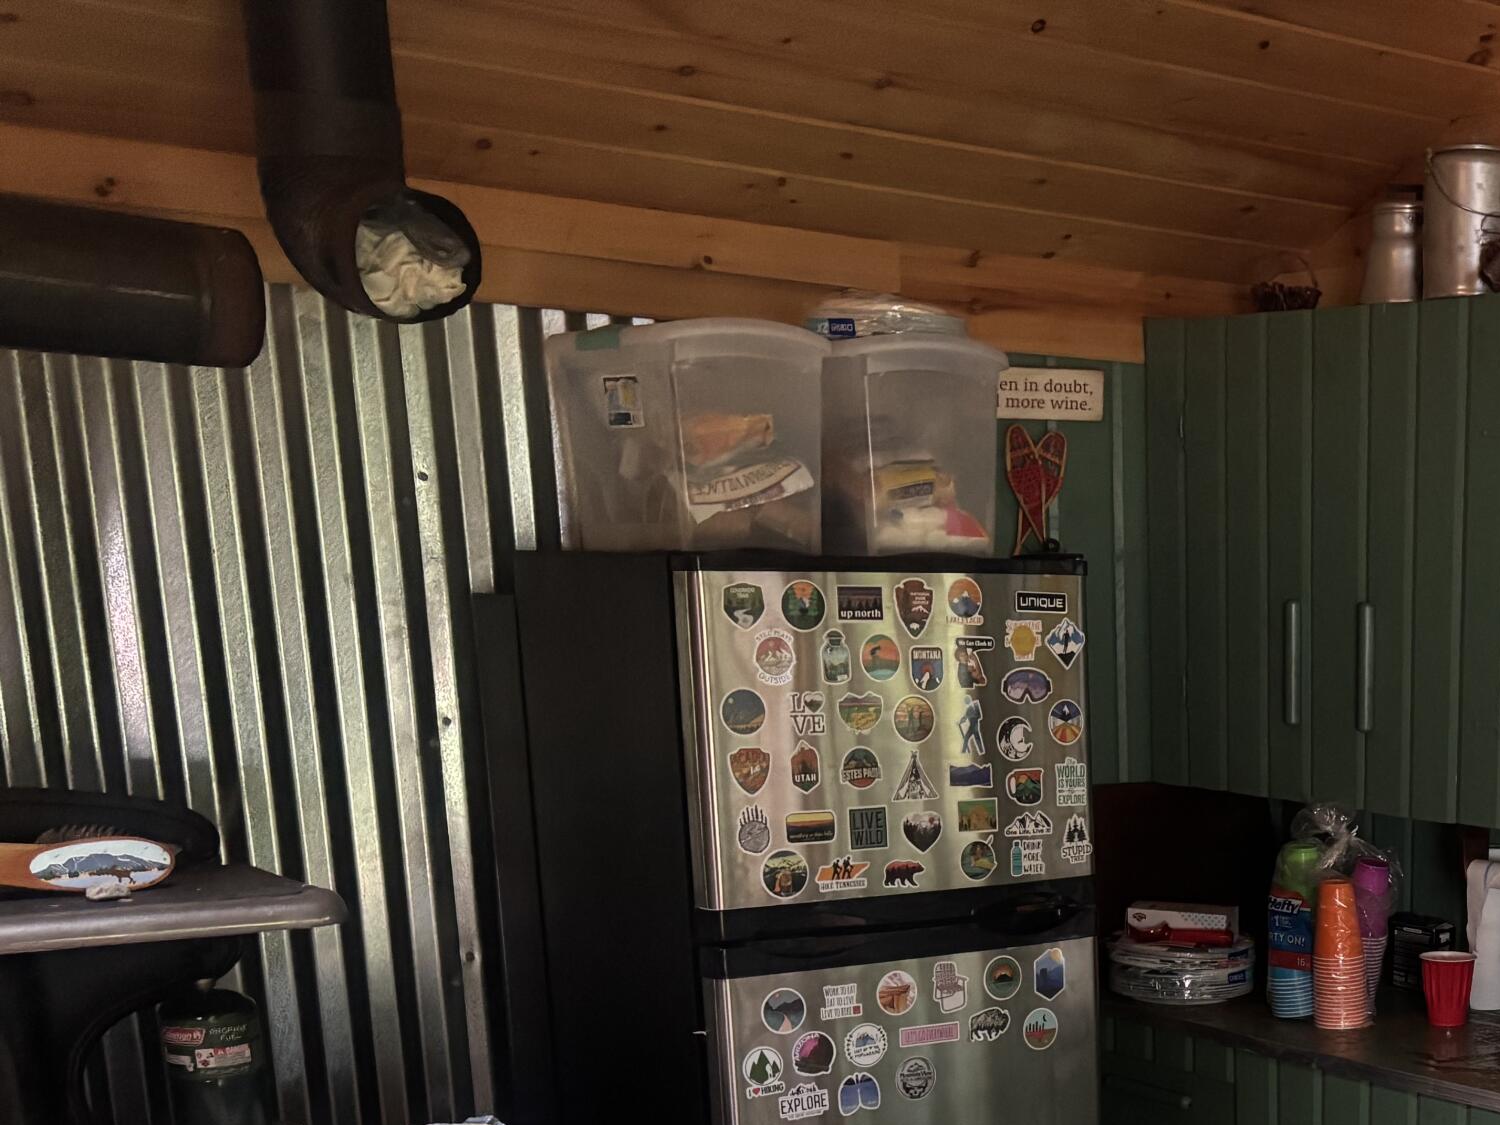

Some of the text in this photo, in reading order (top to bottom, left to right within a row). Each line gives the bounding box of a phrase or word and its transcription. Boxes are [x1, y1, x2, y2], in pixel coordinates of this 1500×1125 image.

[1023, 378, 1039, 392] in
[1043, 378, 1094, 396] doubt,
[1005, 396, 1092, 411] more wine.
[1019, 596, 1064, 609] UNIQUE
[841, 608, 882, 620] up north
[913, 648, 942, 661] MONTANA
[1057, 764, 1086, 778] WORLD
[794, 773, 817, 783] UTAH
[1057, 794, 1086, 804] EXPLORE
[852, 810, 883, 832] LIVE
[853, 830, 885, 846] WILD
[1062, 843, 1092, 856] STUPID
[761, 1084, 784, 1096] HIKING
[780, 1092, 828, 1115] EXPLORE
